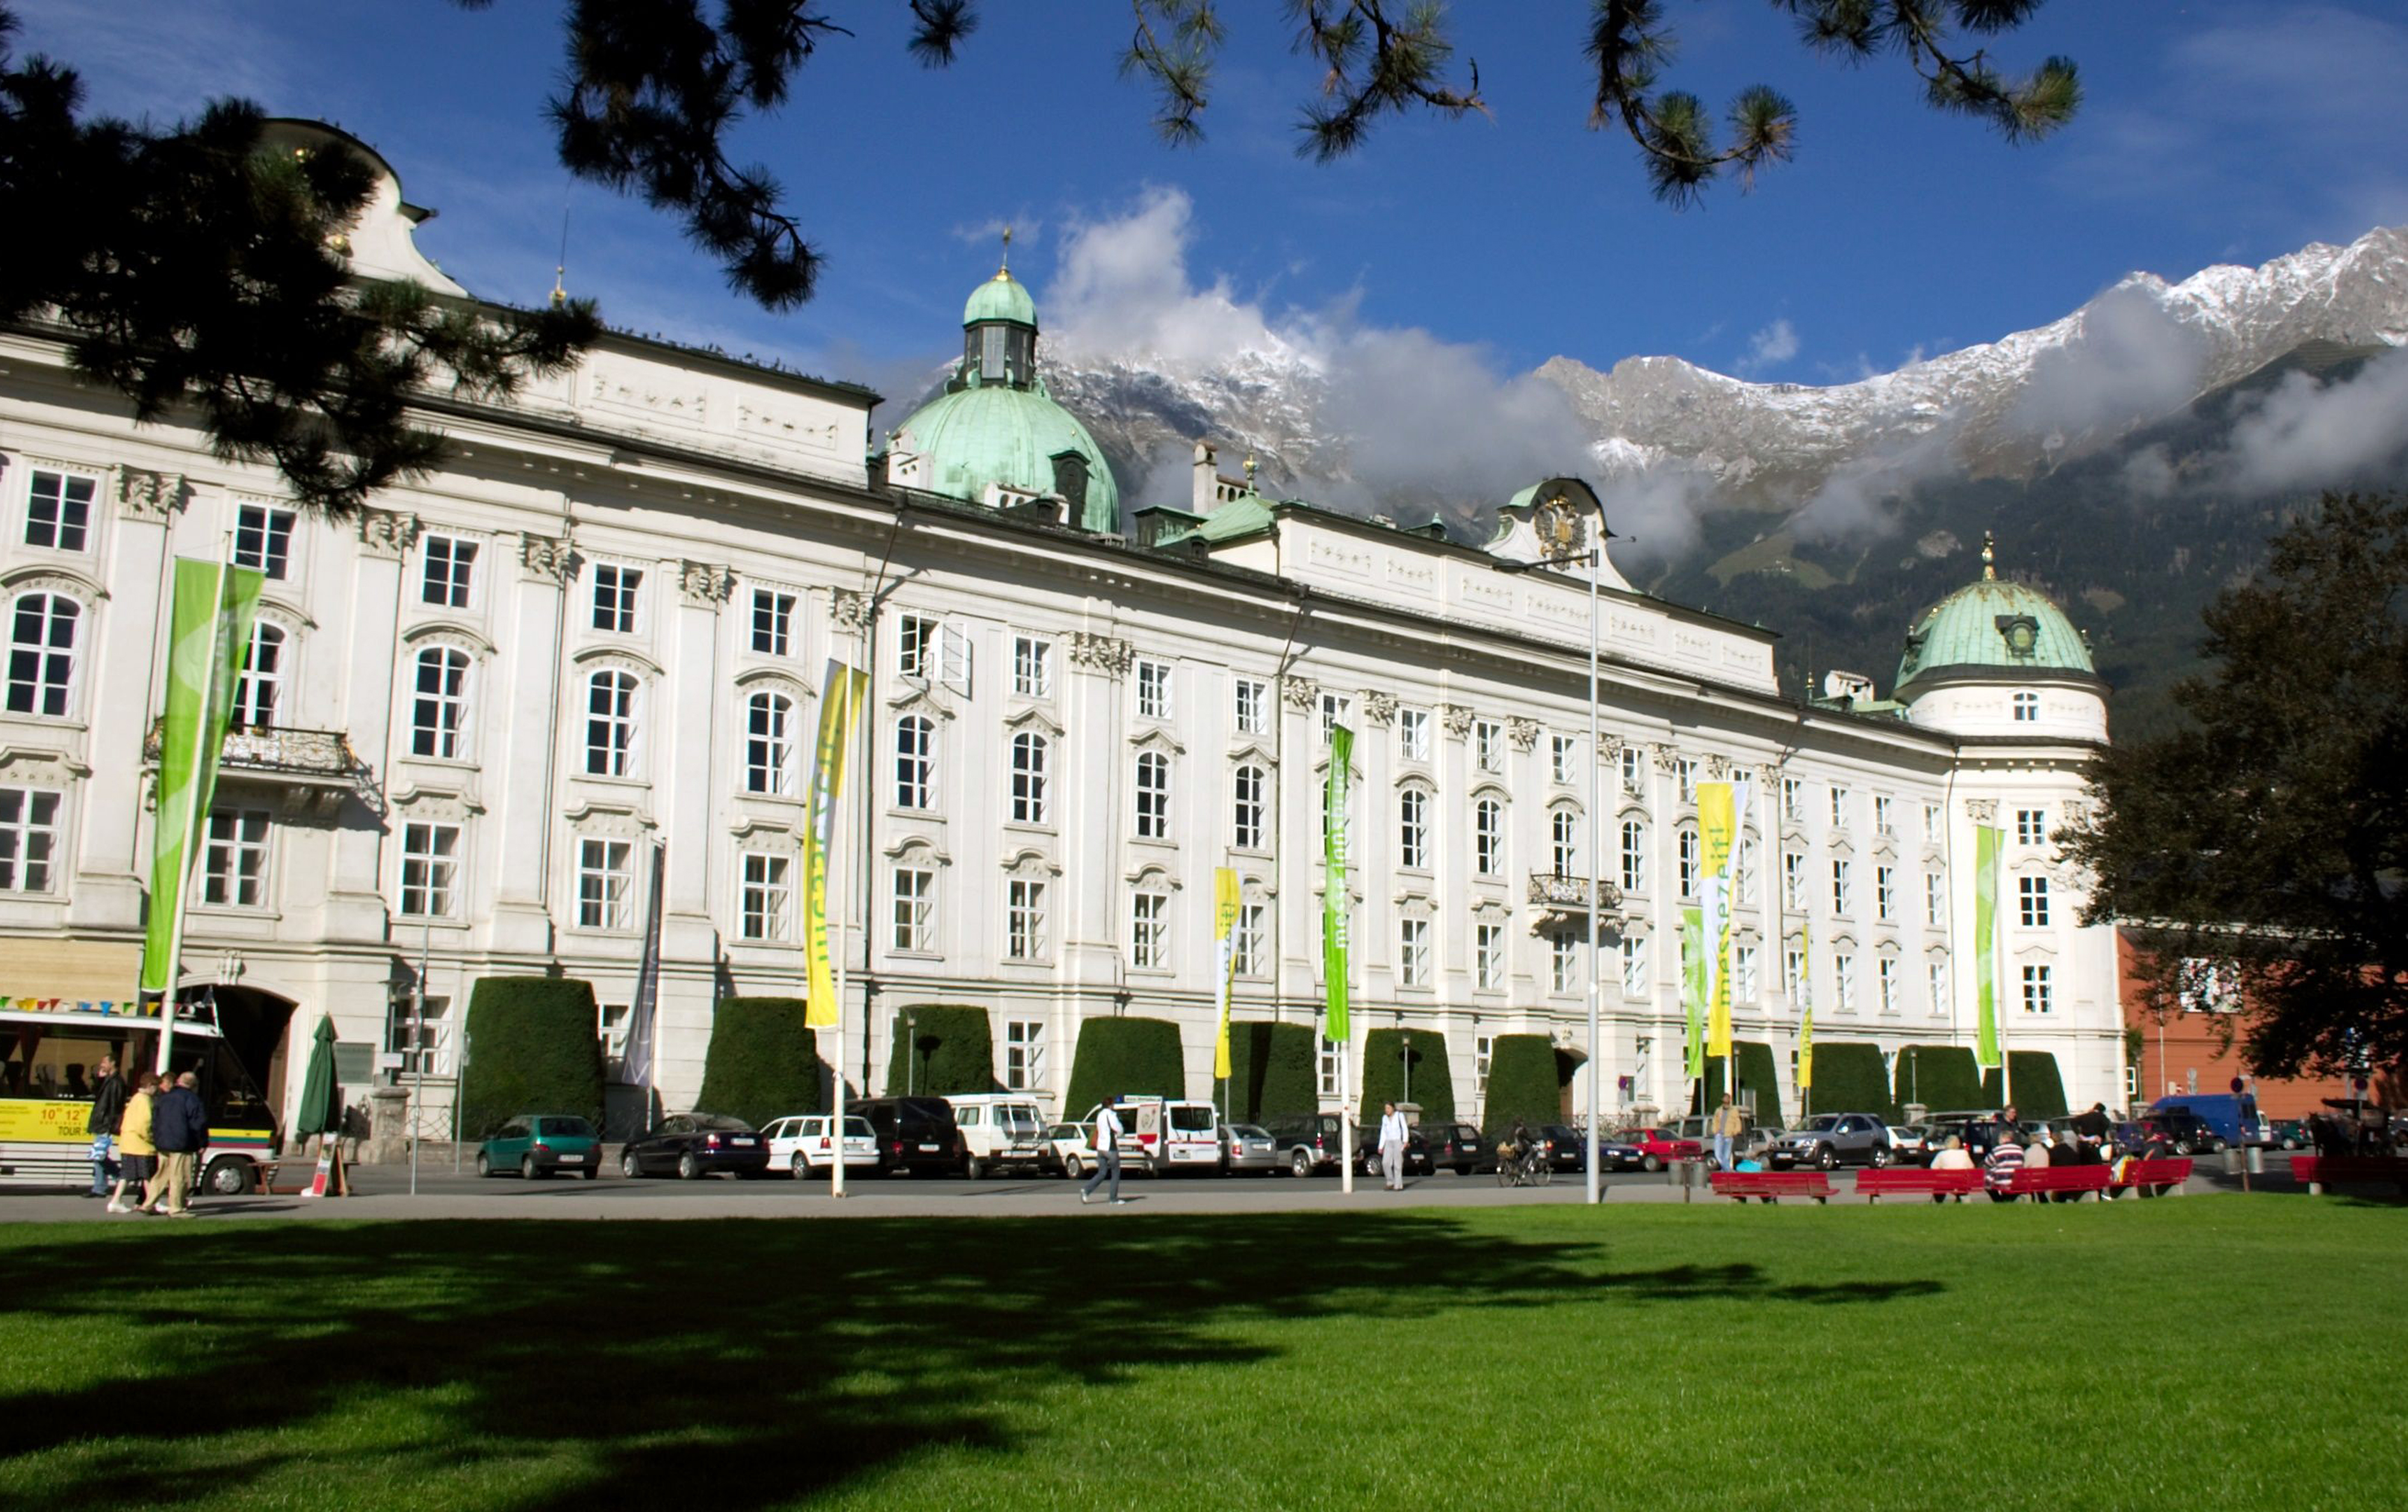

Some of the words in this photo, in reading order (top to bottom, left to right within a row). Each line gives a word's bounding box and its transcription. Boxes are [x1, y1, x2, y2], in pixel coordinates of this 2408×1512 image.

[1335, 878, 1346, 949] messe
[1708, 828, 1731, 1006] messezeit!
[58, 1126, 81, 1136] TOUR
